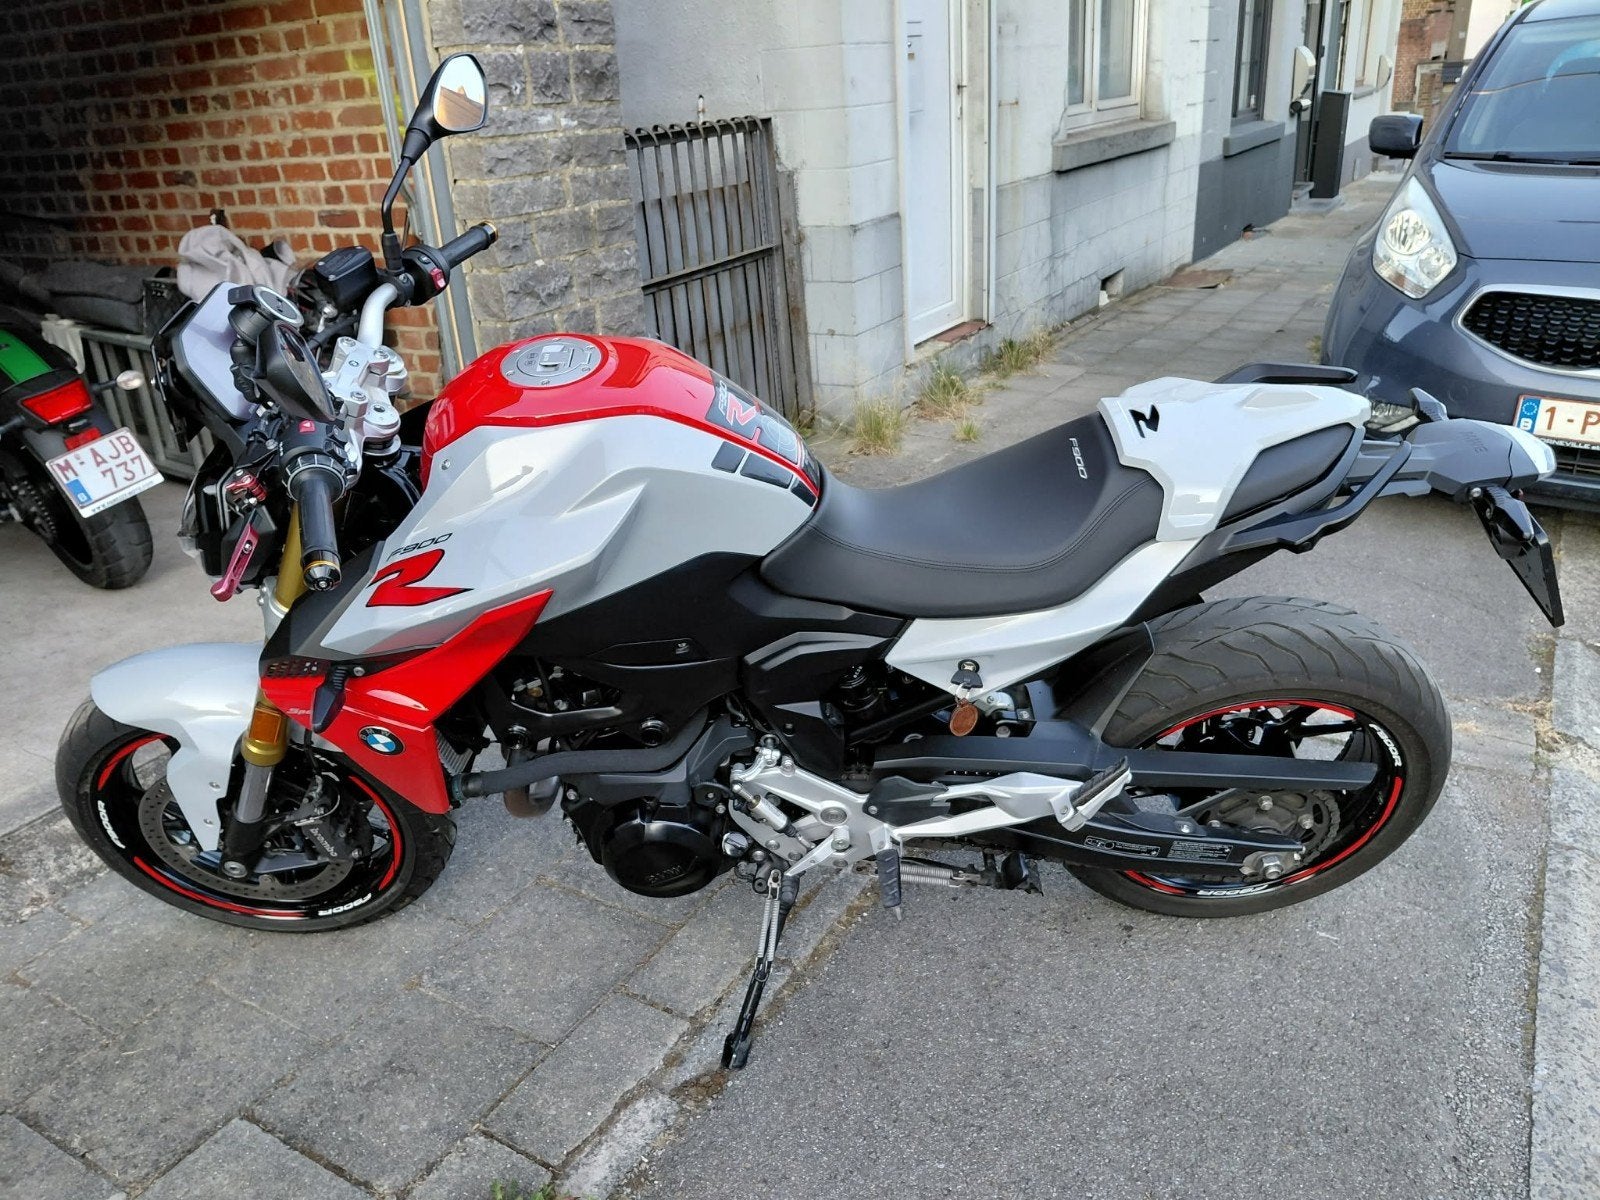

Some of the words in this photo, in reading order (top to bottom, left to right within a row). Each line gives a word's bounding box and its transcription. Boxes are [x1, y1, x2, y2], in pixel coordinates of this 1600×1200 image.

[101, 455, 146, 488] 737
[1069, 437, 1088, 479] F900
[386, 532, 453, 562] F900
[365, 548, 475, 608] R
[309, 827, 338, 857] brembo
